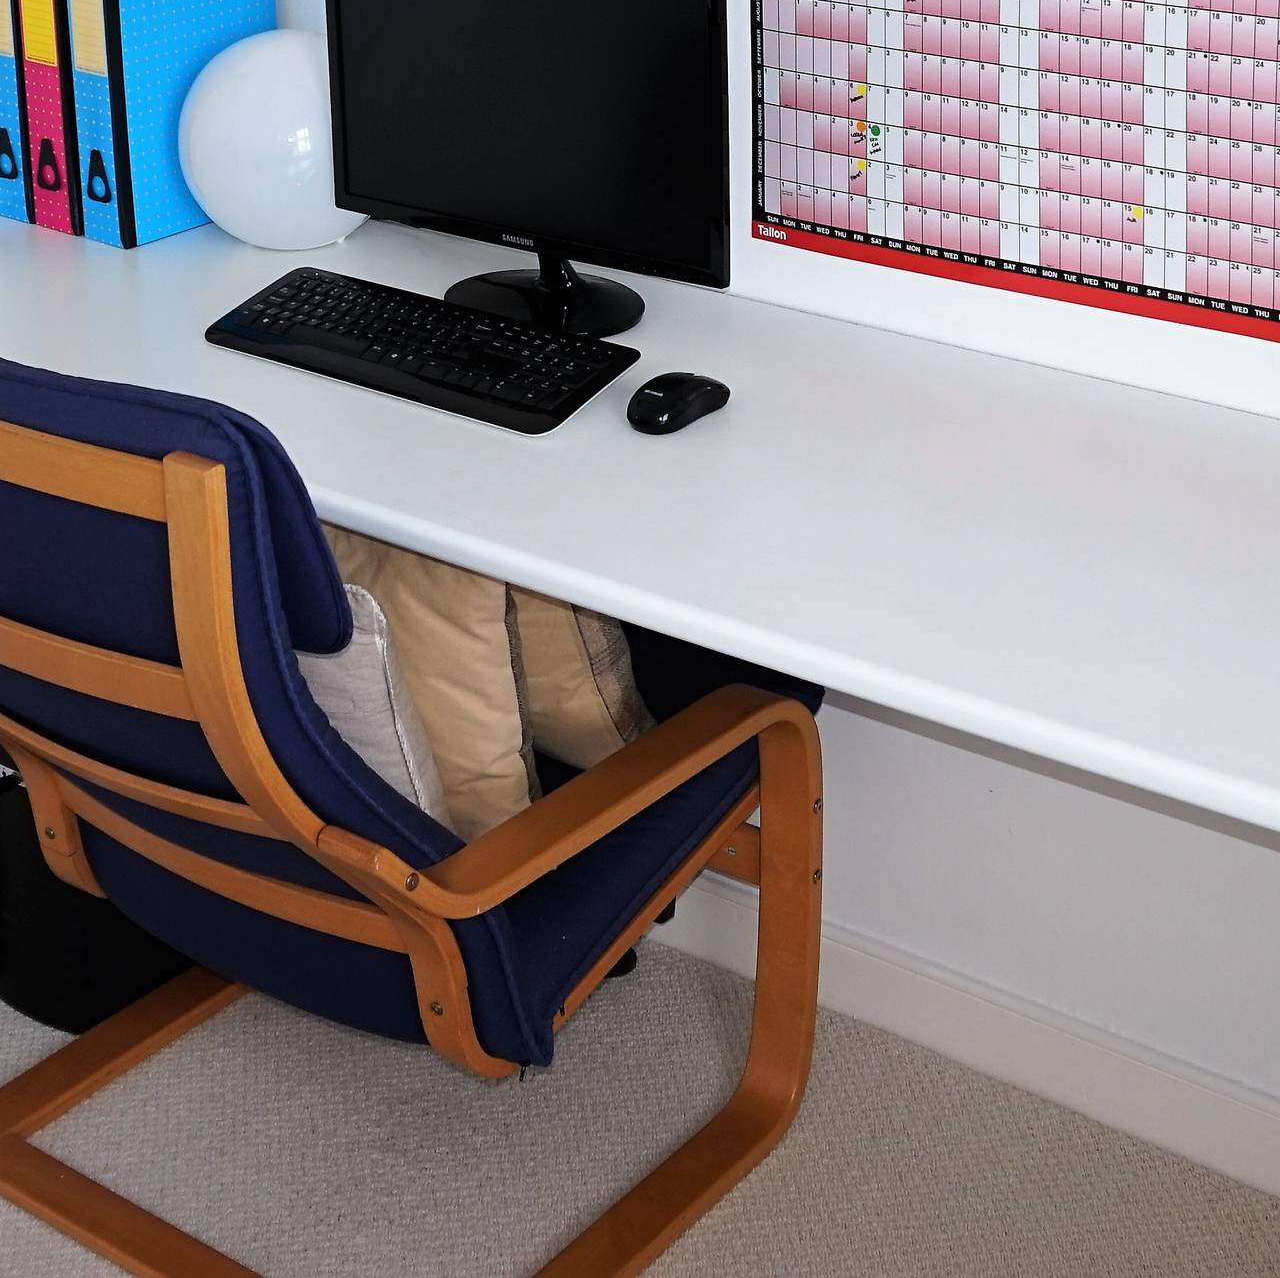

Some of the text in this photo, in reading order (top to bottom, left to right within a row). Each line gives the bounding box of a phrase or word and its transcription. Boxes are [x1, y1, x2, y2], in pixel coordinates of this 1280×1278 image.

[501, 233, 534, 247] SAMSUNG
[758, 224, 787, 241] Tallon
[767, 215, 779, 224] SUN
[782, 218, 796, 228] MON
[799, 222, 812, 231] TUE
[815, 226, 830, 235] WED
[834, 229, 847, 239] THU
[853, 233, 864, 242] FRI
[870, 236, 883, 246] SAT
[888, 240, 902, 249] SUN
[905, 244, 921, 254] MON
[925, 247, 939, 257] TUE
[943, 251, 959, 260] WED
[963, 254, 978, 264] THU
[984, 258, 996, 267] FRI
[1003, 262, 1017, 271] SAT
[1022, 265, 1037, 275] SUN
[1041, 269, 1058, 280] MON
[1063, 273, 1077, 283] TUE
[1082, 276, 1099, 286] WED
[1103, 280, 1119, 290] THU
[1126, 285, 1139, 294] FRI
[1146, 288, 1161, 298] SAT
[1167, 292, 1183, 302] SUN
[1187, 296, 1205, 306] MON
[1210, 300, 1226, 310] TUE
[1231, 304, 1249, 314] WED
[1254, 308, 1270, 319] THU
